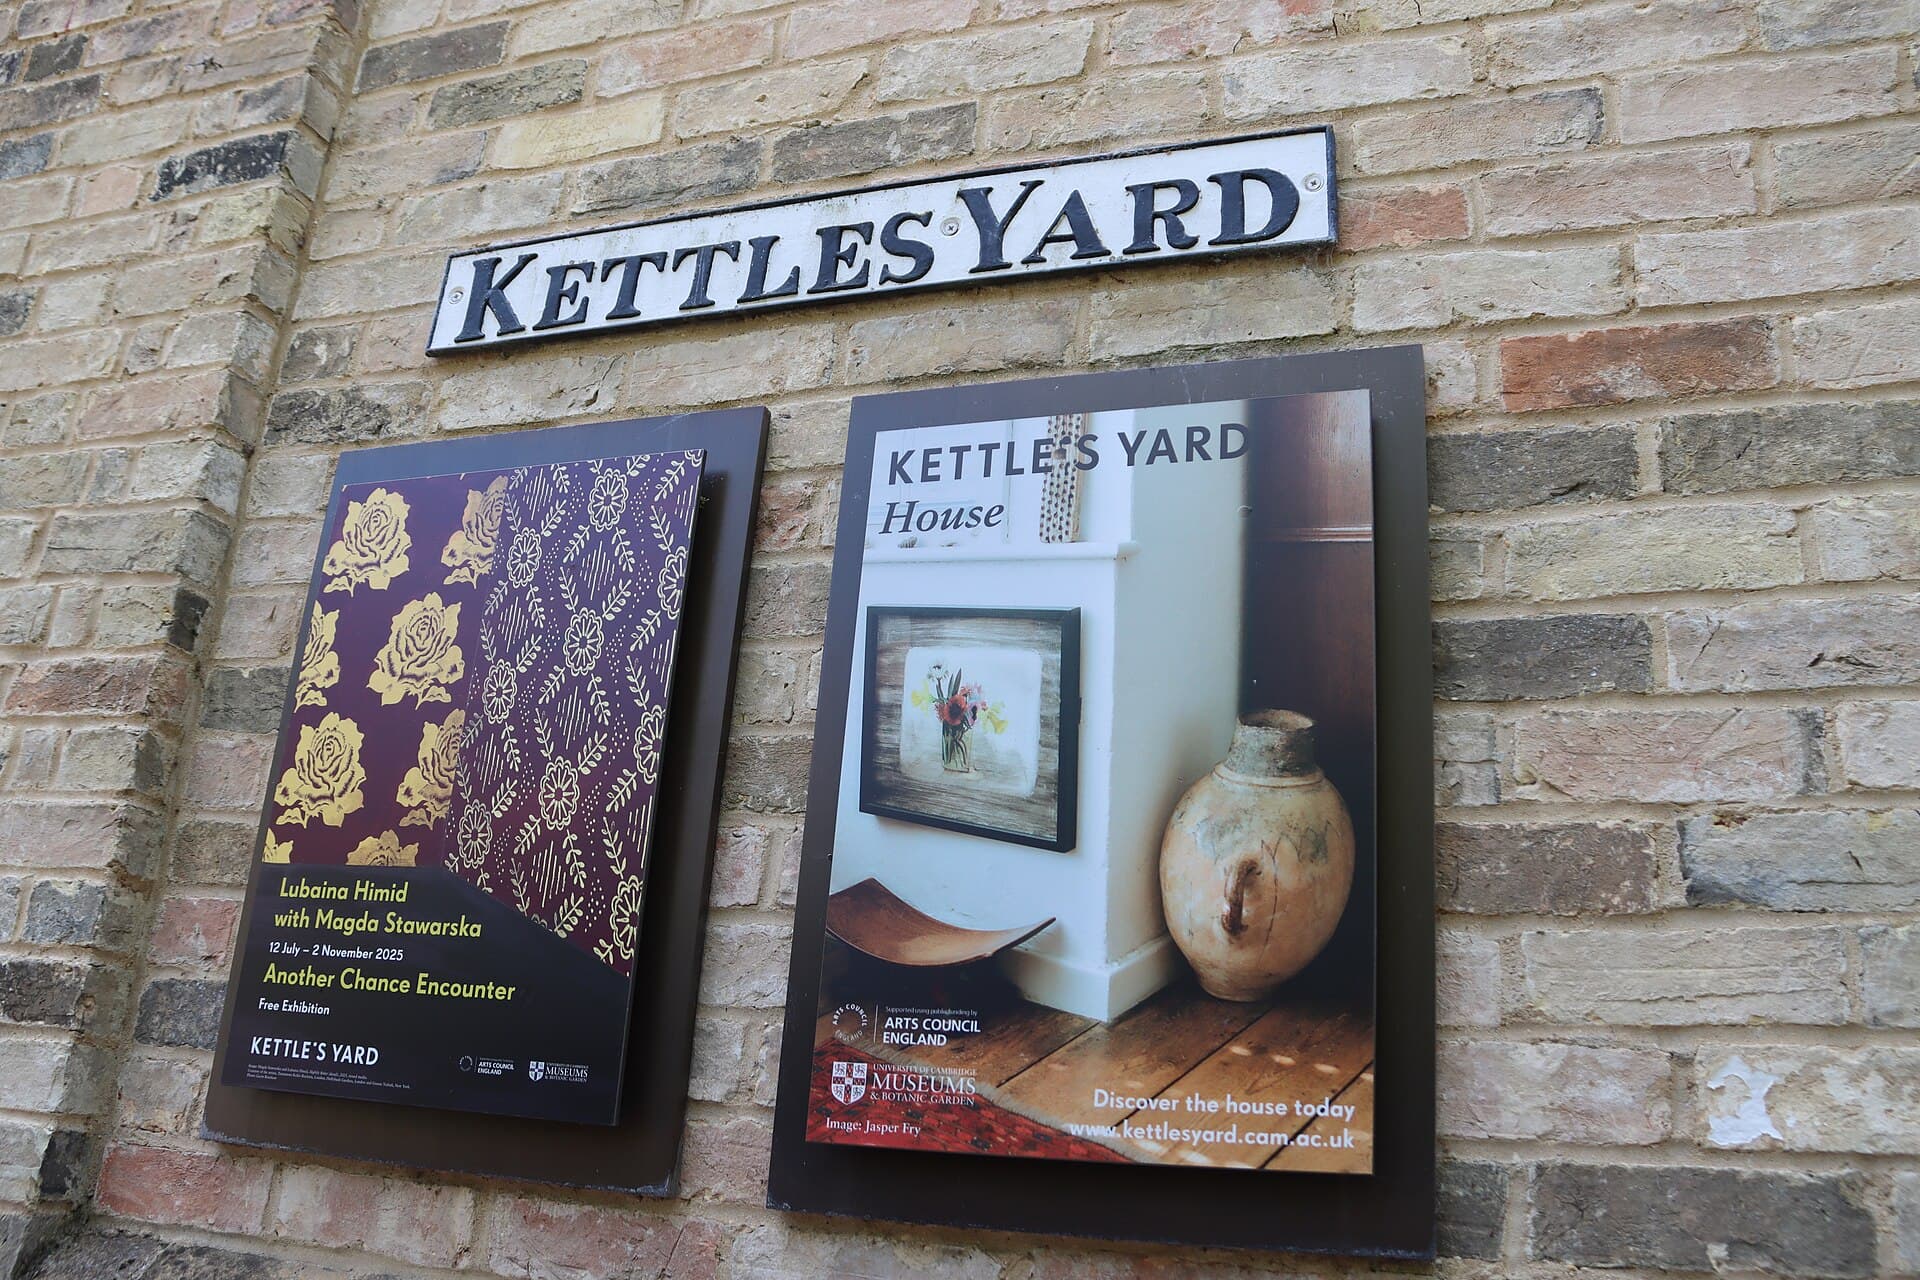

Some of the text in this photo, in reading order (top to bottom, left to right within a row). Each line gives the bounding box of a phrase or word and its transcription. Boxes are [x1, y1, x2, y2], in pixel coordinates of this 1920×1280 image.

[454, 168, 1300, 343] KETTLES YARD
[888, 423, 1250, 486] KETTLE'S YARD
[878, 499, 1004, 534] House
[279, 877, 409, 903] Lubaina Himid
[274, 907, 482, 938] with Magda Stawarska
[269, 941, 281, 954] 12
[282, 942, 301, 957] July
[312, 944, 320, 956] 2
[322, 944, 373, 960] November
[375, 948, 404, 961] 2025
[263, 963, 516, 1001] Another Chance Encounter
[258, 997, 330, 1016] Free Exhibition
[832, 1003, 868, 1027] ARTS COUNCIL
[884, 1017, 981, 1033] ARTS COUNCIL
[883, 1031, 947, 1046] ENGLAND
[250, 1036, 379, 1066] KETTLE'S YARD
[545, 1066, 588, 1078] MUSEUMS
[873, 1063, 919, 1073] UNIVERSITY
[930, 1066, 977, 1076] CAMBRIDGE
[871, 1072, 976, 1095] MUSEUMS
[870, 1091, 975, 1106] & BOTANIC GARDEN
[1093, 1088, 1355, 1122] Discover the house today
[826, 1117, 921, 1137] Image: Jasper Fry
[1069, 1118, 1355, 1149] www.kettlesyard.cam.ac.uk
